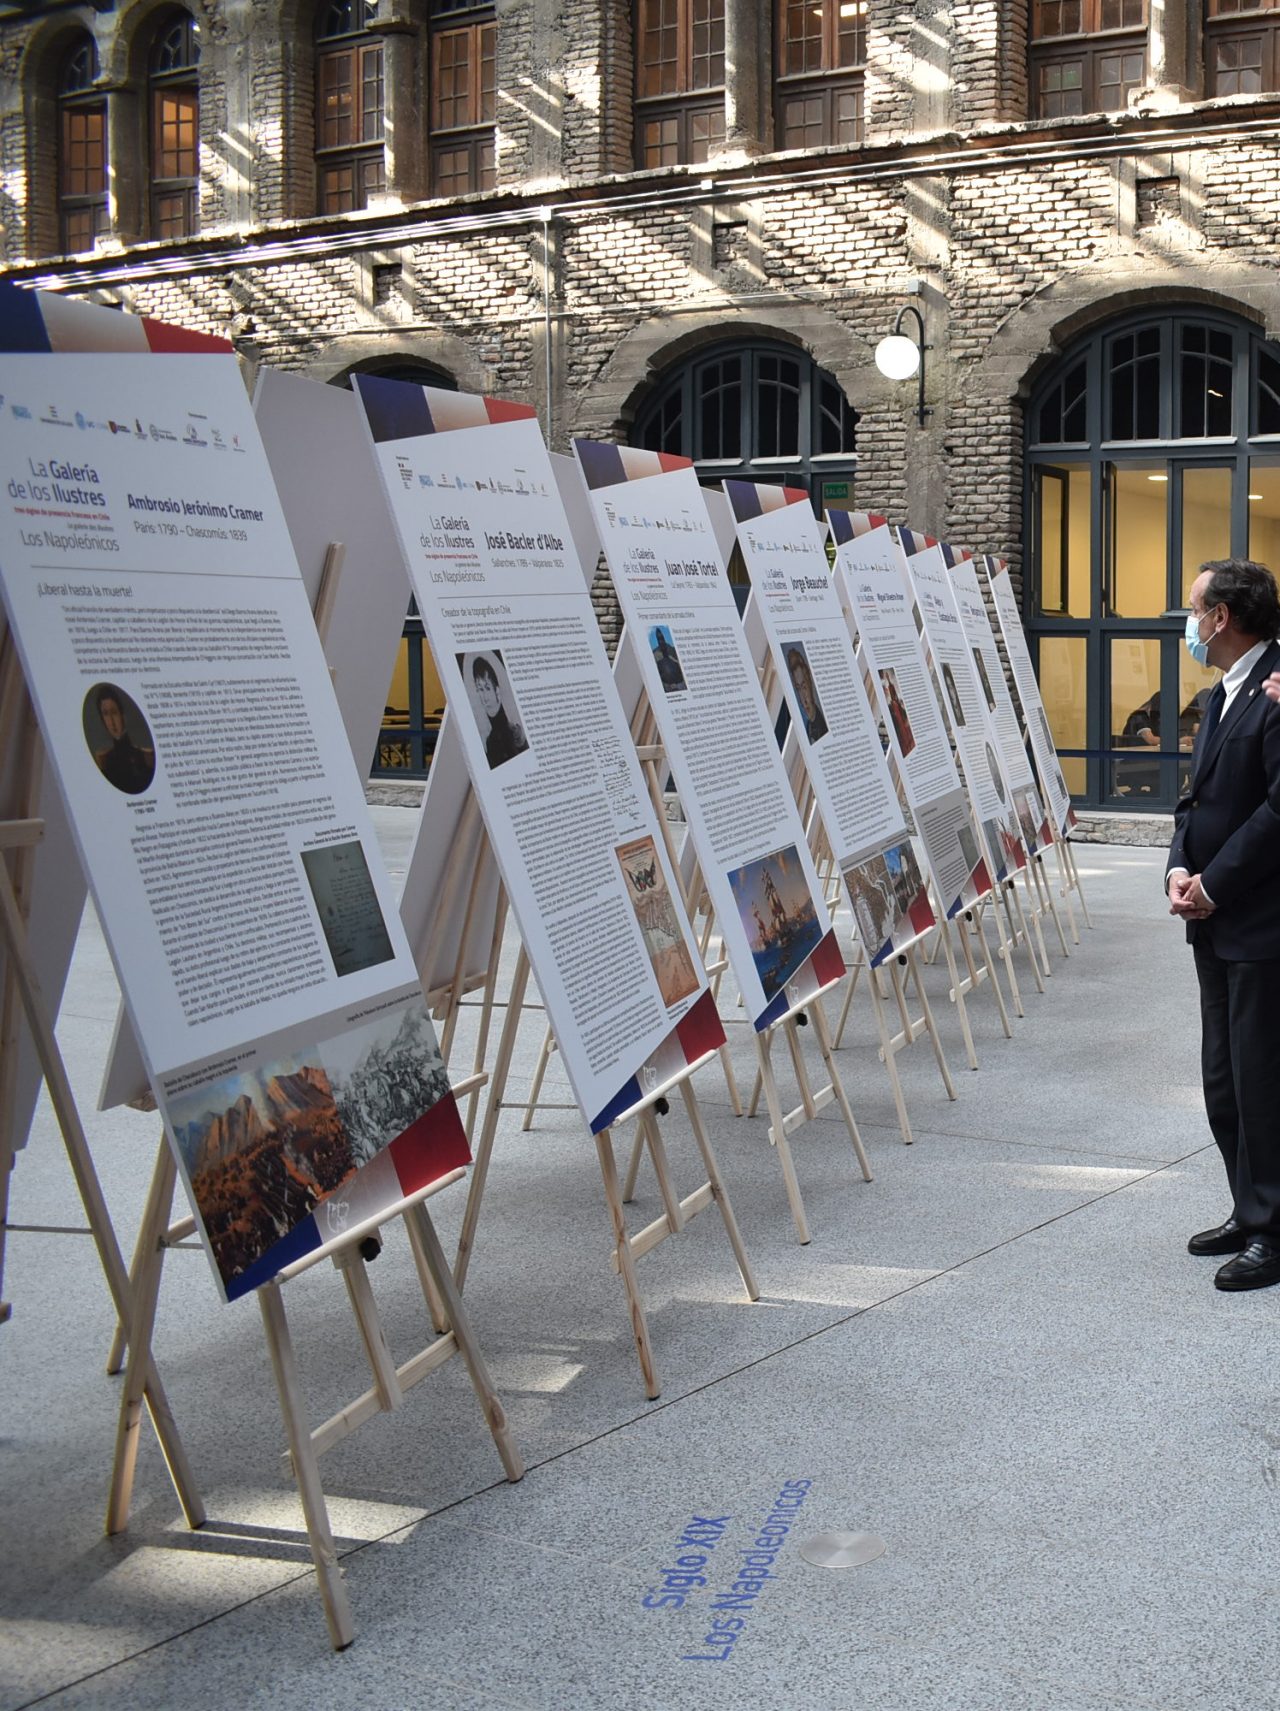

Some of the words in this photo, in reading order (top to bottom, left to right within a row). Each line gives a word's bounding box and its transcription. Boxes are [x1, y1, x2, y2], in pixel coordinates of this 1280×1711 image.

[29, 457, 49, 478] La
[49, 460, 100, 483] Galería
[8, 478, 27, 499] de
[28, 480, 51, 502] los
[52, 483, 106, 507] Ilustres
[127, 493, 181, 514] Ambrosio
[181, 499, 228, 519] Jerónimo
[228, 504, 264, 521] Cramer
[157, 523, 178, 536] 1790
[229, 529, 248, 541] 1839
[429, 515, 442, 530] La
[20, 529, 43, 546] Los
[43, 530, 120, 552] Napoleónicos
[420, 532, 431, 548] de
[430, 533, 444, 548] los
[444, 533, 475, 548] Ilustres
[484, 531, 507, 550] José
[506, 532, 536, 550] Bacler
[429, 570, 443, 583] Los
[664, 559, 684, 576] Juan
[682, 559, 699, 576] José
[68, 583, 93, 597] hasta
[92, 584, 102, 597] la
[460, 607, 467, 617] de
[709, 1479, 813, 1610] Napoleónicos
[642, 1555, 708, 1610] Siglo
[675, 1514, 732, 1550] XIX
[682, 1617, 745, 1662] Los
